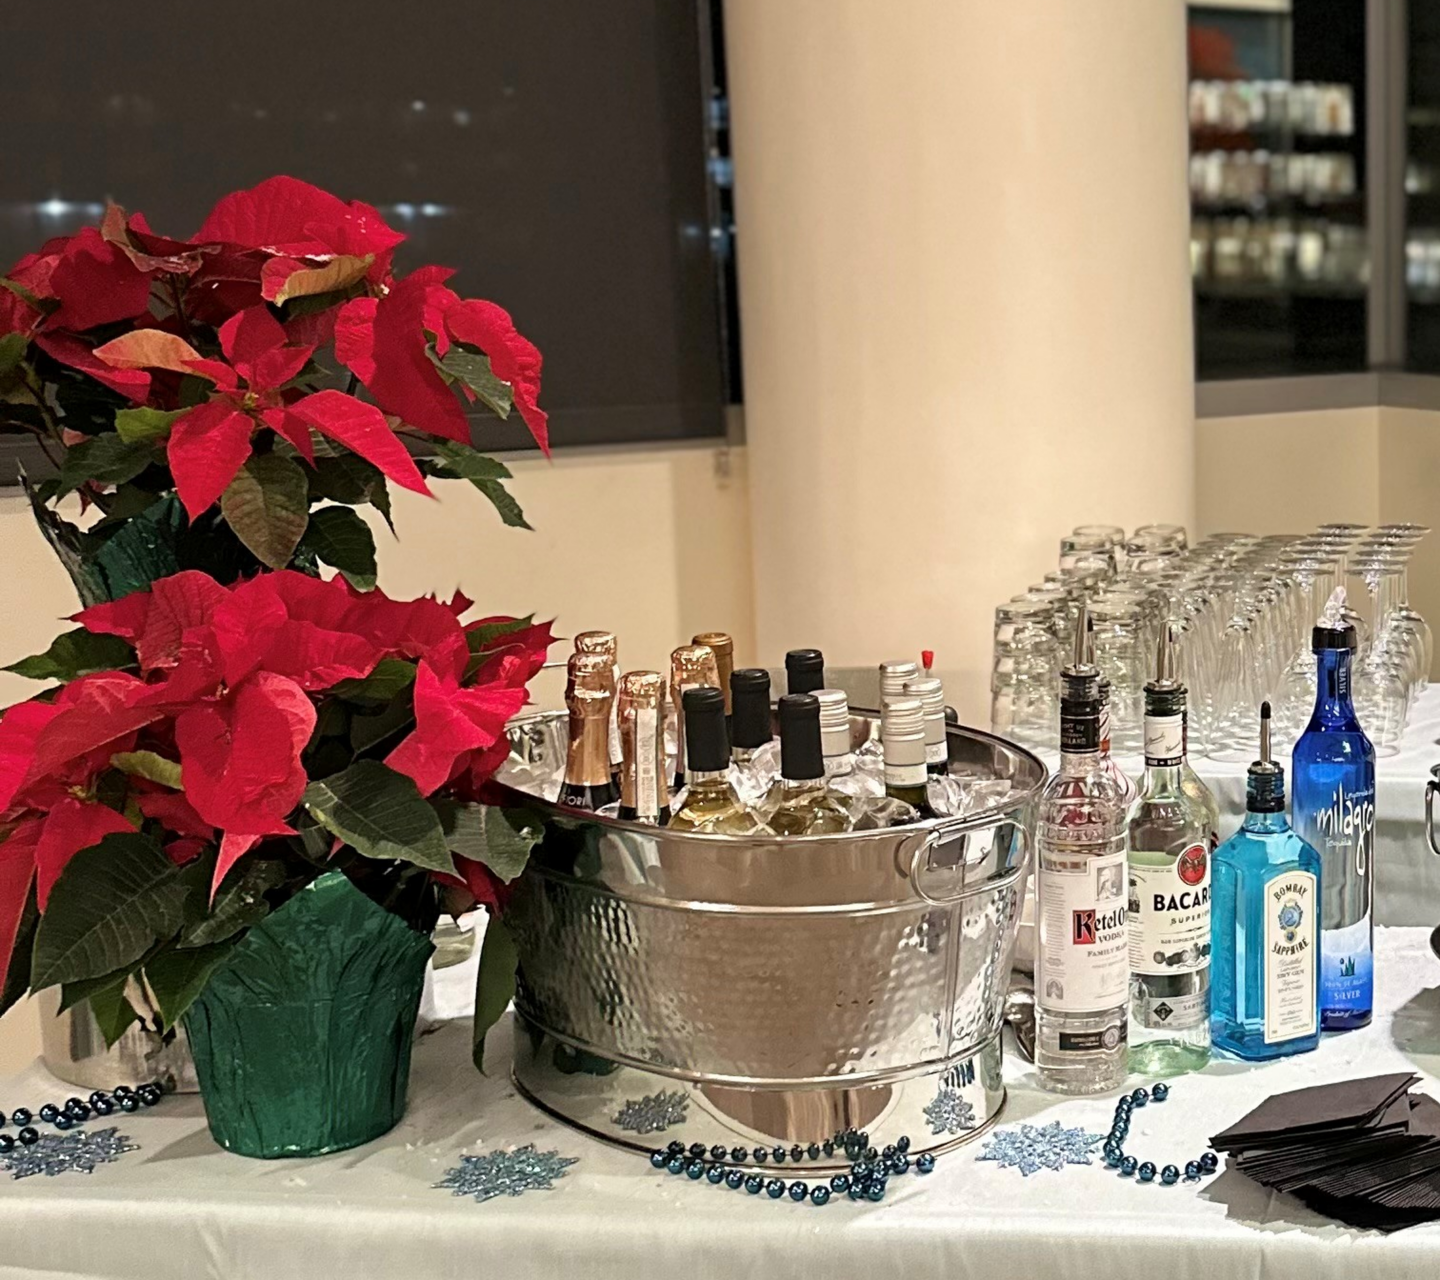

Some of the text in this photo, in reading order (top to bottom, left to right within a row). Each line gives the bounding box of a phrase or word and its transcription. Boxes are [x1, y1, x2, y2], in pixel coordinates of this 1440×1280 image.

[1339, 667, 1347, 694] SILVER
[1316, 780, 1374, 876] milagro
[1273, 883, 1308, 902] BOMBAY
[1075, 909, 1117, 942] Ketel
[1272, 935, 1310, 956] SAPPHIRE
[1334, 989, 1361, 1001] SILVER
